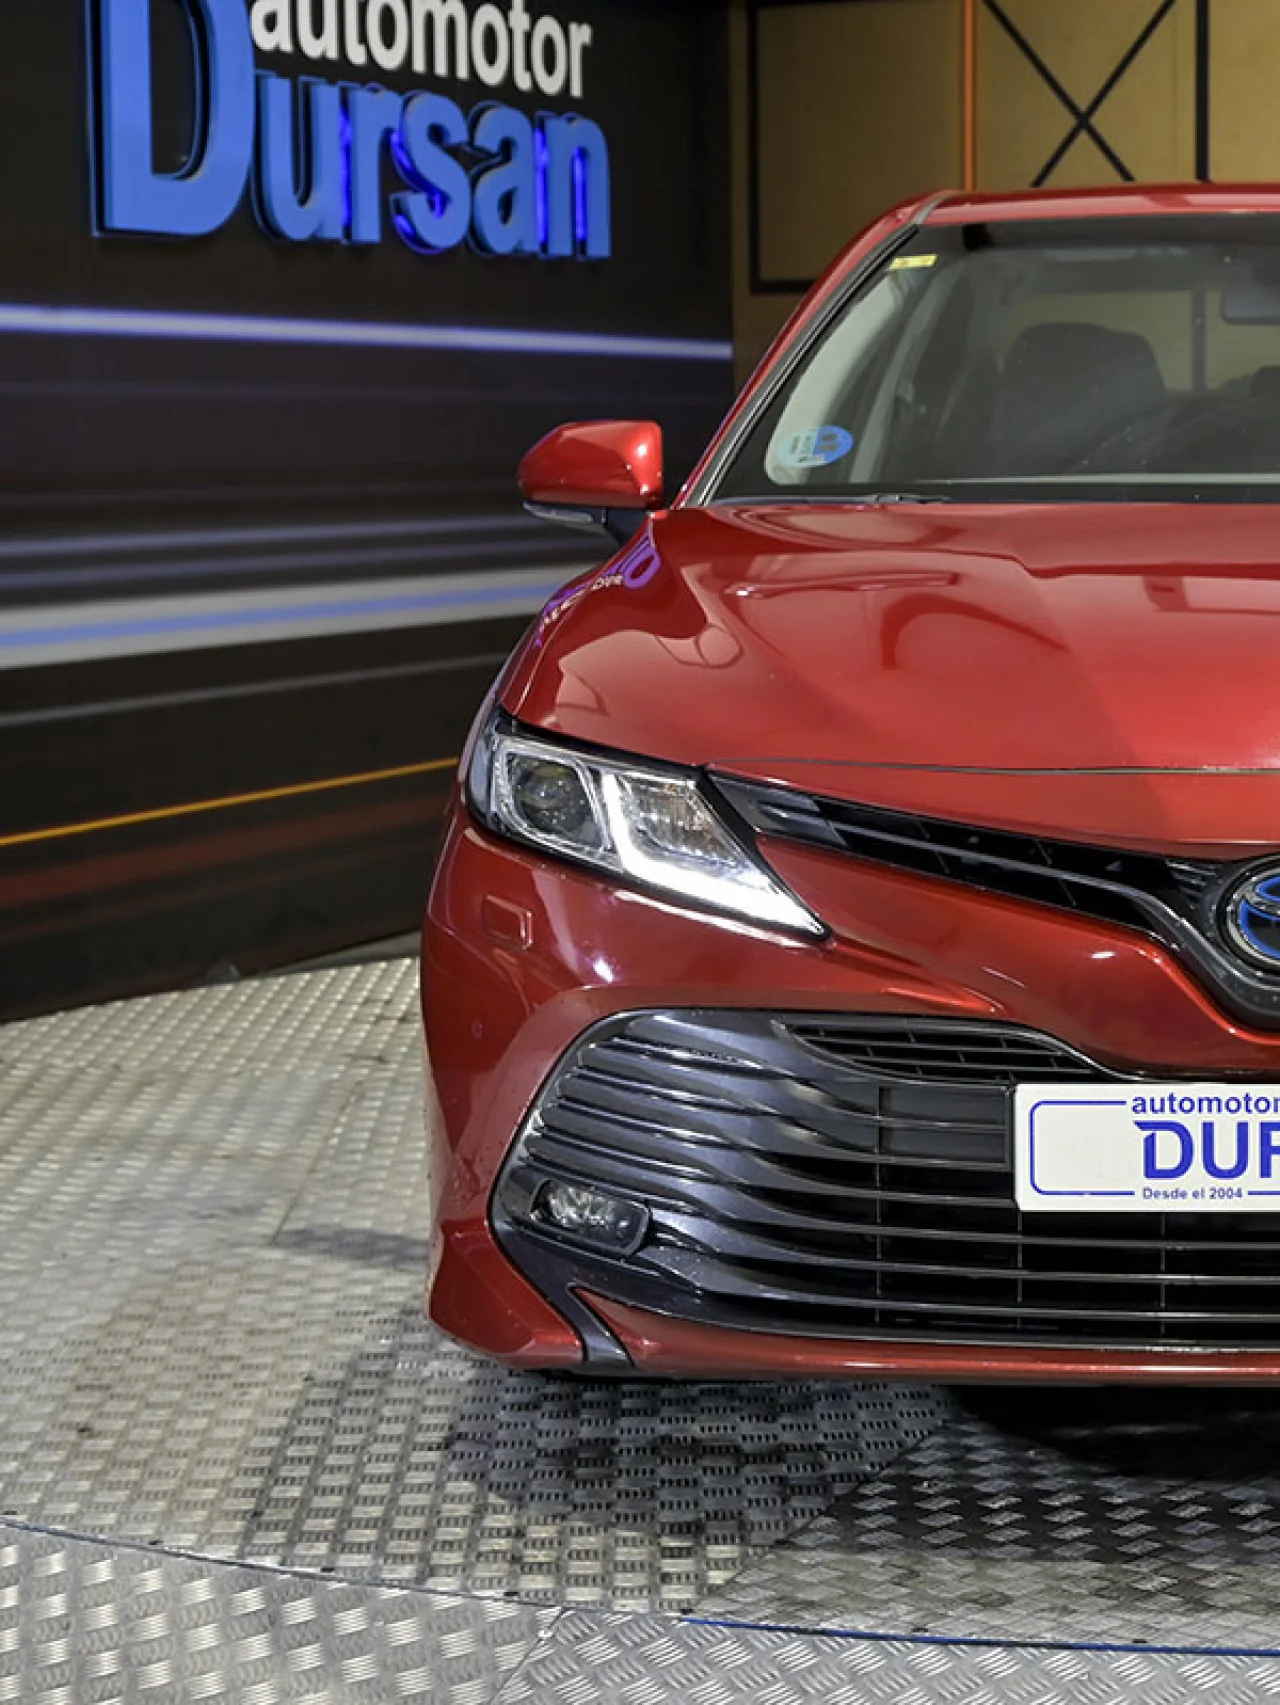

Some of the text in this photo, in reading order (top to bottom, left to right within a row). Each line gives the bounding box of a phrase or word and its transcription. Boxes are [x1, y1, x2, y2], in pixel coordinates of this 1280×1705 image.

[250, 0, 593, 98] automotor
[89, 0, 611, 259] Dursan
[1142, 1187, 1243, 1200] Desde el 2004
